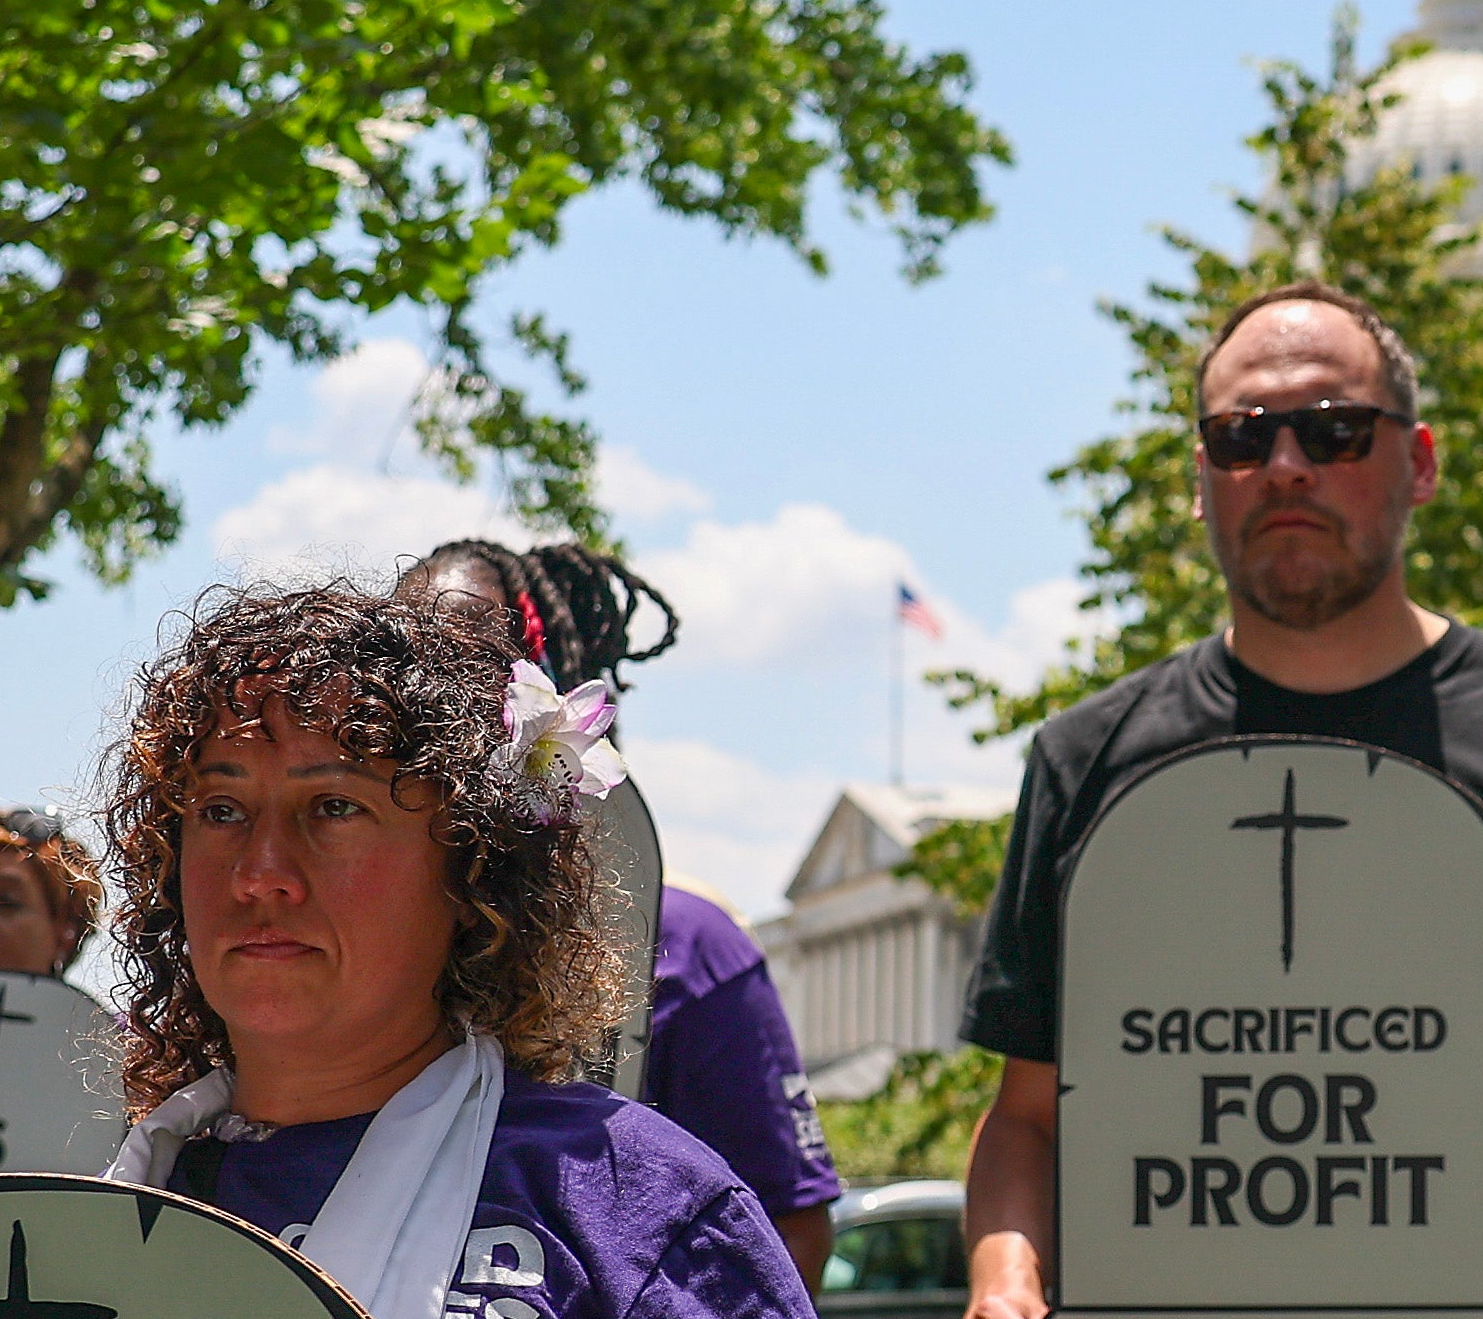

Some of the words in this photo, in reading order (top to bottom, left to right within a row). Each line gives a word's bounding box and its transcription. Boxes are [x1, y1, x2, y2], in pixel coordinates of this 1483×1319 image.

[1120, 1004, 1448, 1055] SACRIFICED
[1200, 1072, 1378, 1146] FOR
[1132, 1154, 1446, 1228] PROFIT
